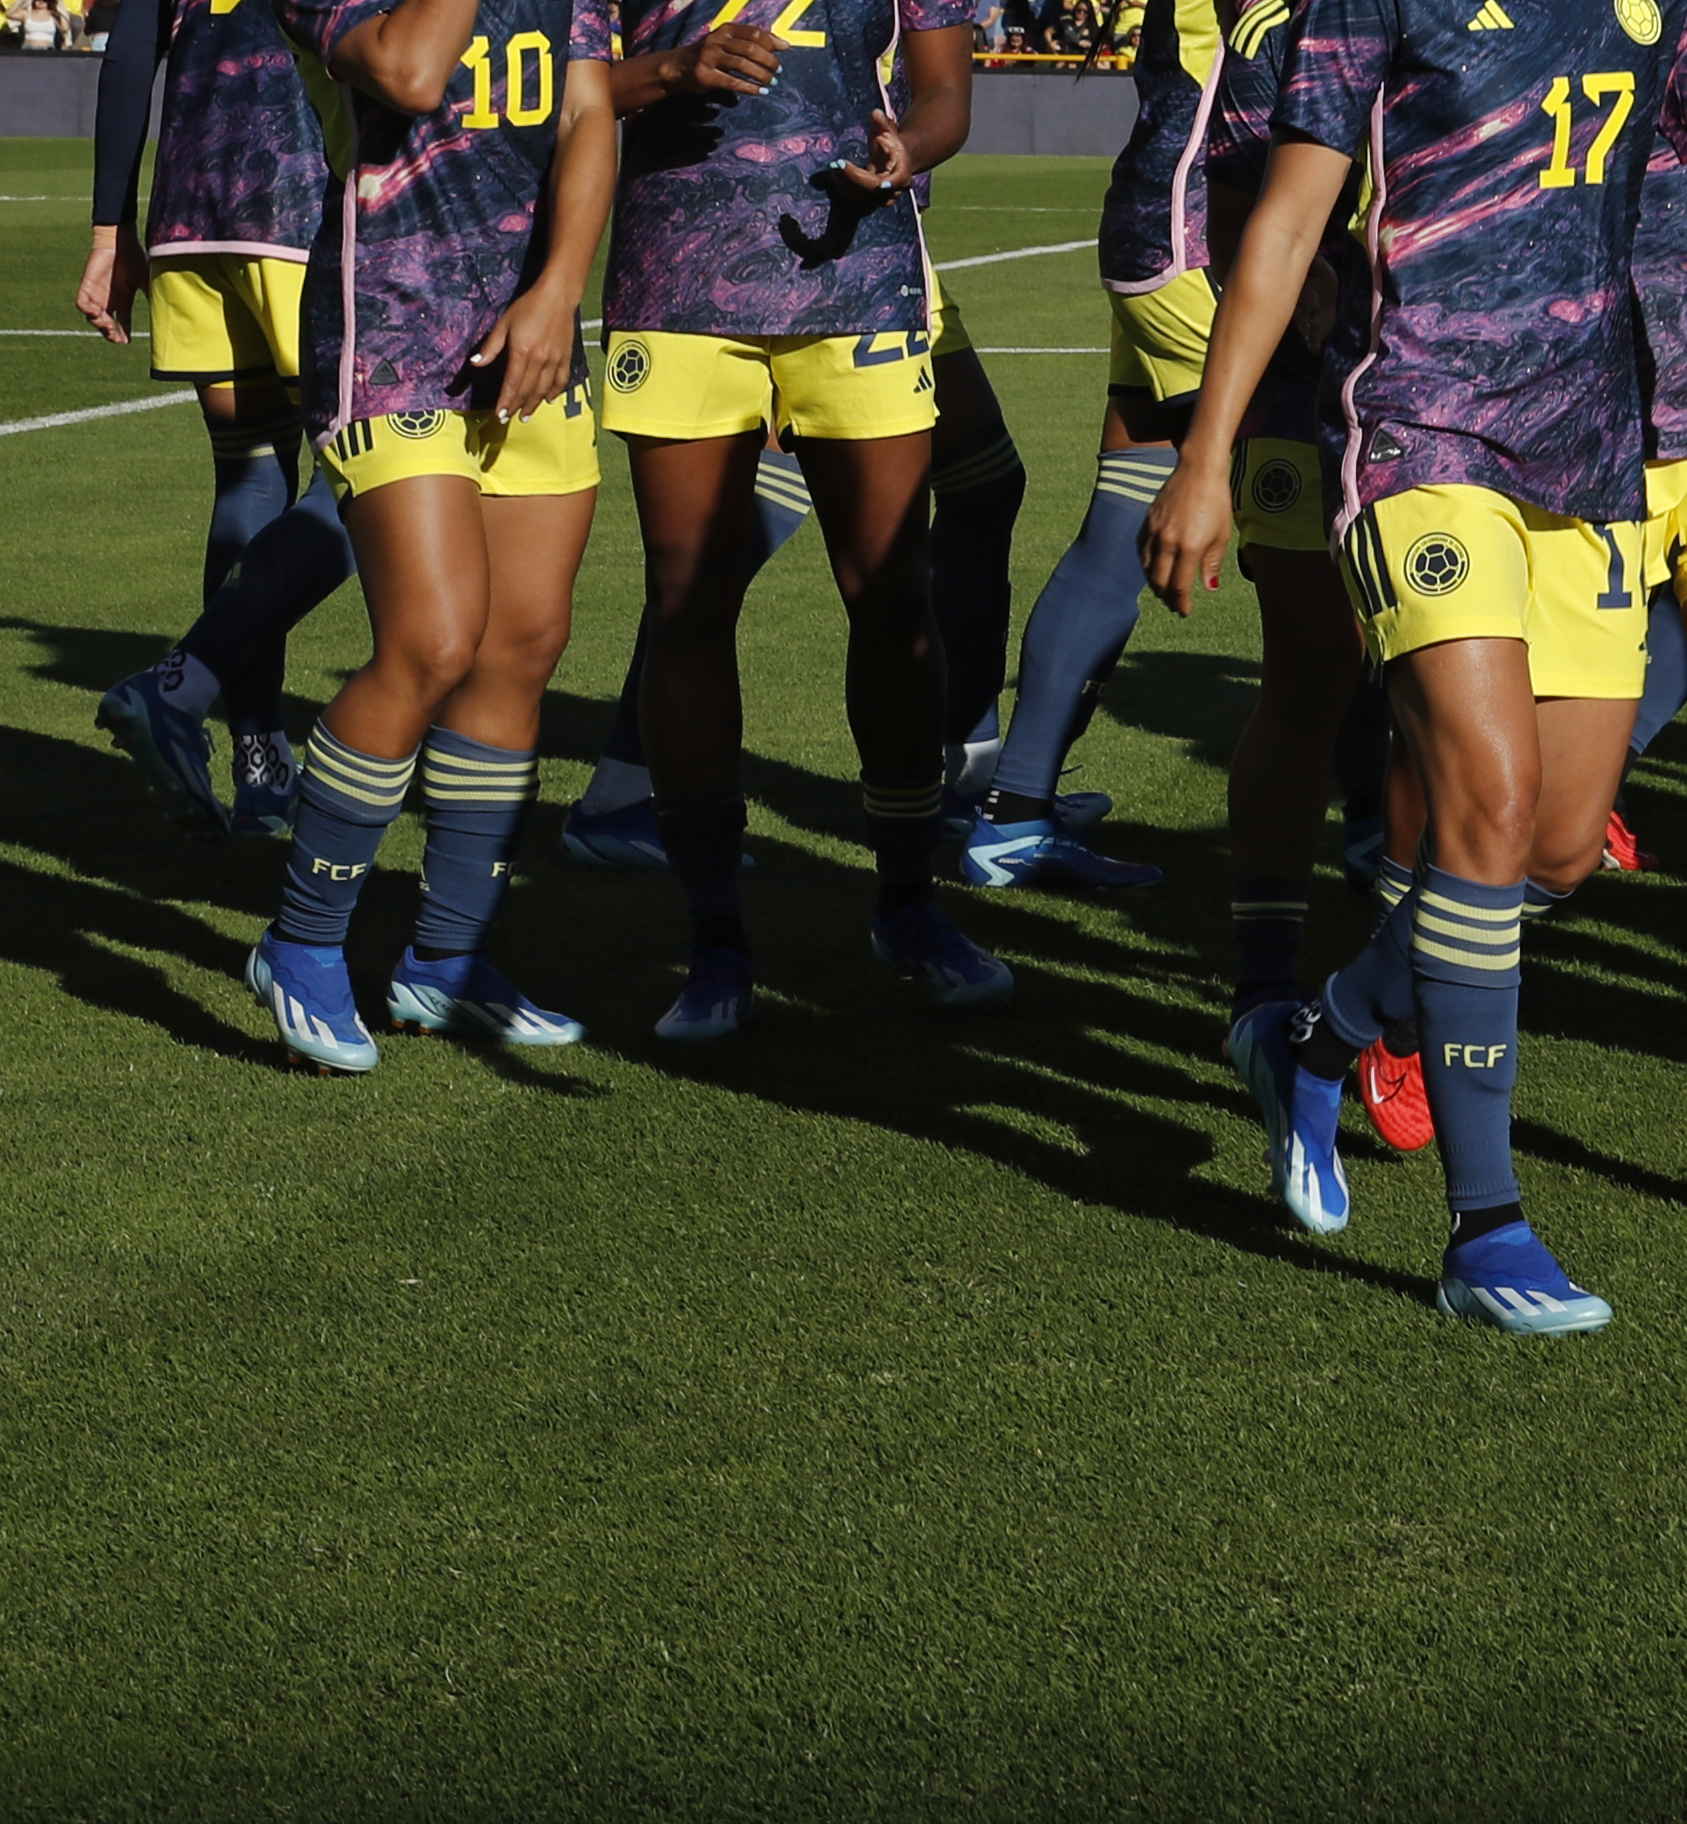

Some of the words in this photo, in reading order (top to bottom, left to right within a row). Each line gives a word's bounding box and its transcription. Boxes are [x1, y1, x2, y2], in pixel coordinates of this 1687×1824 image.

[460, 31, 553, 129] 10
[1539, 71, 1636, 189] 17
[312, 857, 367, 881] FCF
[1443, 1042, 1508, 1068] FCF
